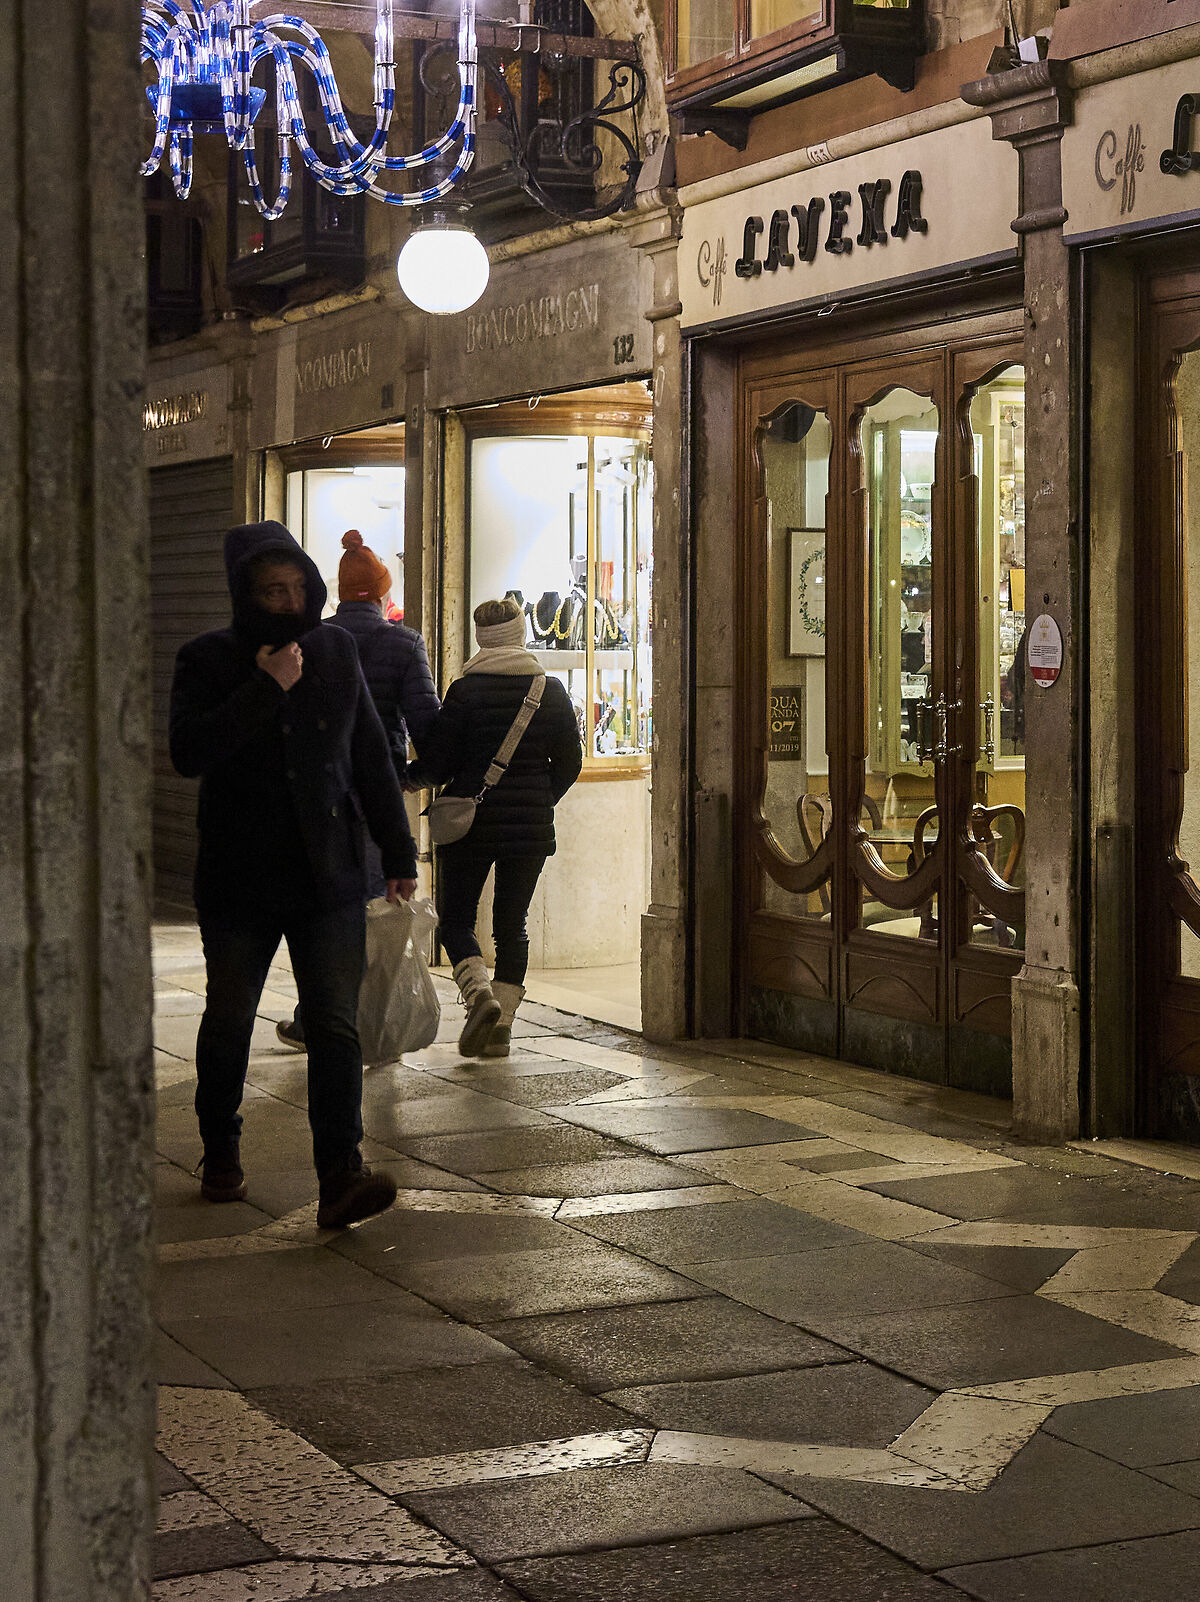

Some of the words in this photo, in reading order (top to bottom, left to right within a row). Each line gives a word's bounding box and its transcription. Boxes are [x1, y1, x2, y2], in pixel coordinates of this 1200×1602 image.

[735, 169, 928, 278] LAVENA
[465, 284, 600, 354] BONCOMPAGNI
[770, 696, 799, 710] QUA
[771, 708, 800, 718] ANDA
[771, 720, 796, 732] 07
[769, 743, 800, 752] 11/2019
